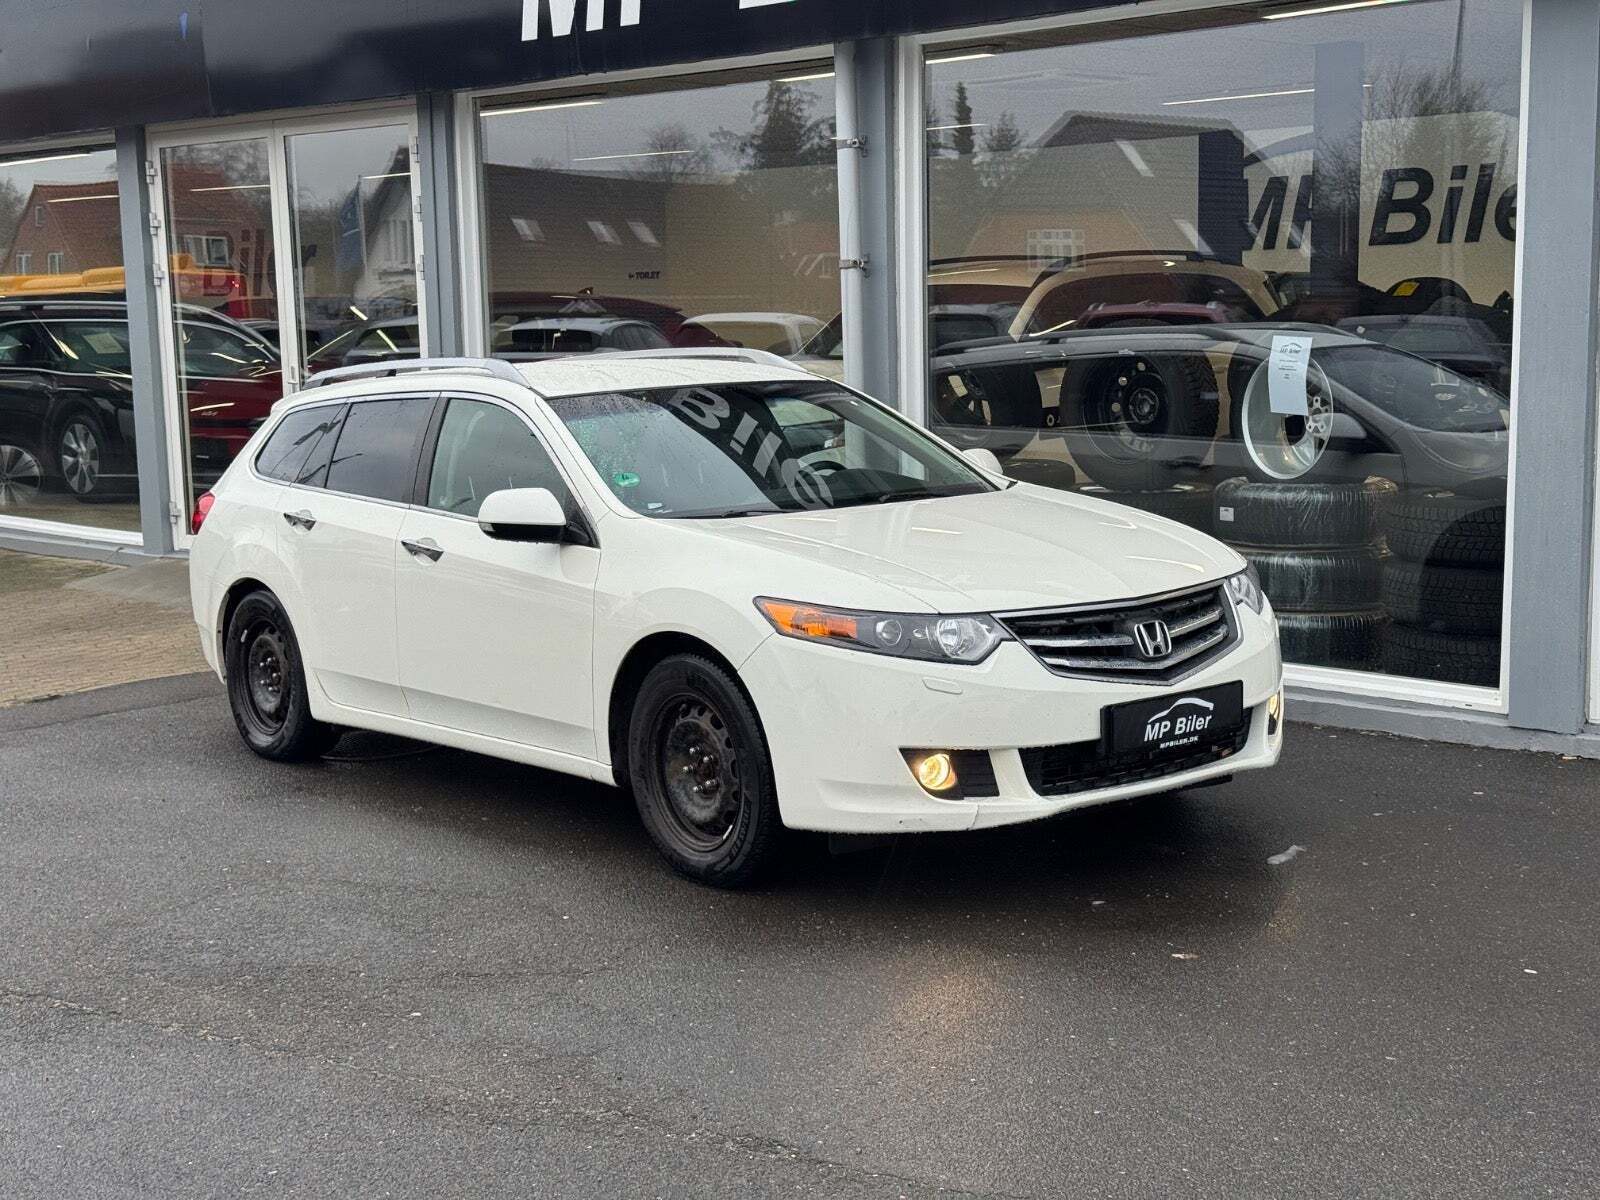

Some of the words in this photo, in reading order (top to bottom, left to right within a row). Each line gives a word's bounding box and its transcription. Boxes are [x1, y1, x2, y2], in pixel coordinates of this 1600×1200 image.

[1143, 720, 1171, 742] MP
[1174, 714, 1213, 735] Biler
[1159, 735, 1200, 749] MPBILER.DK
